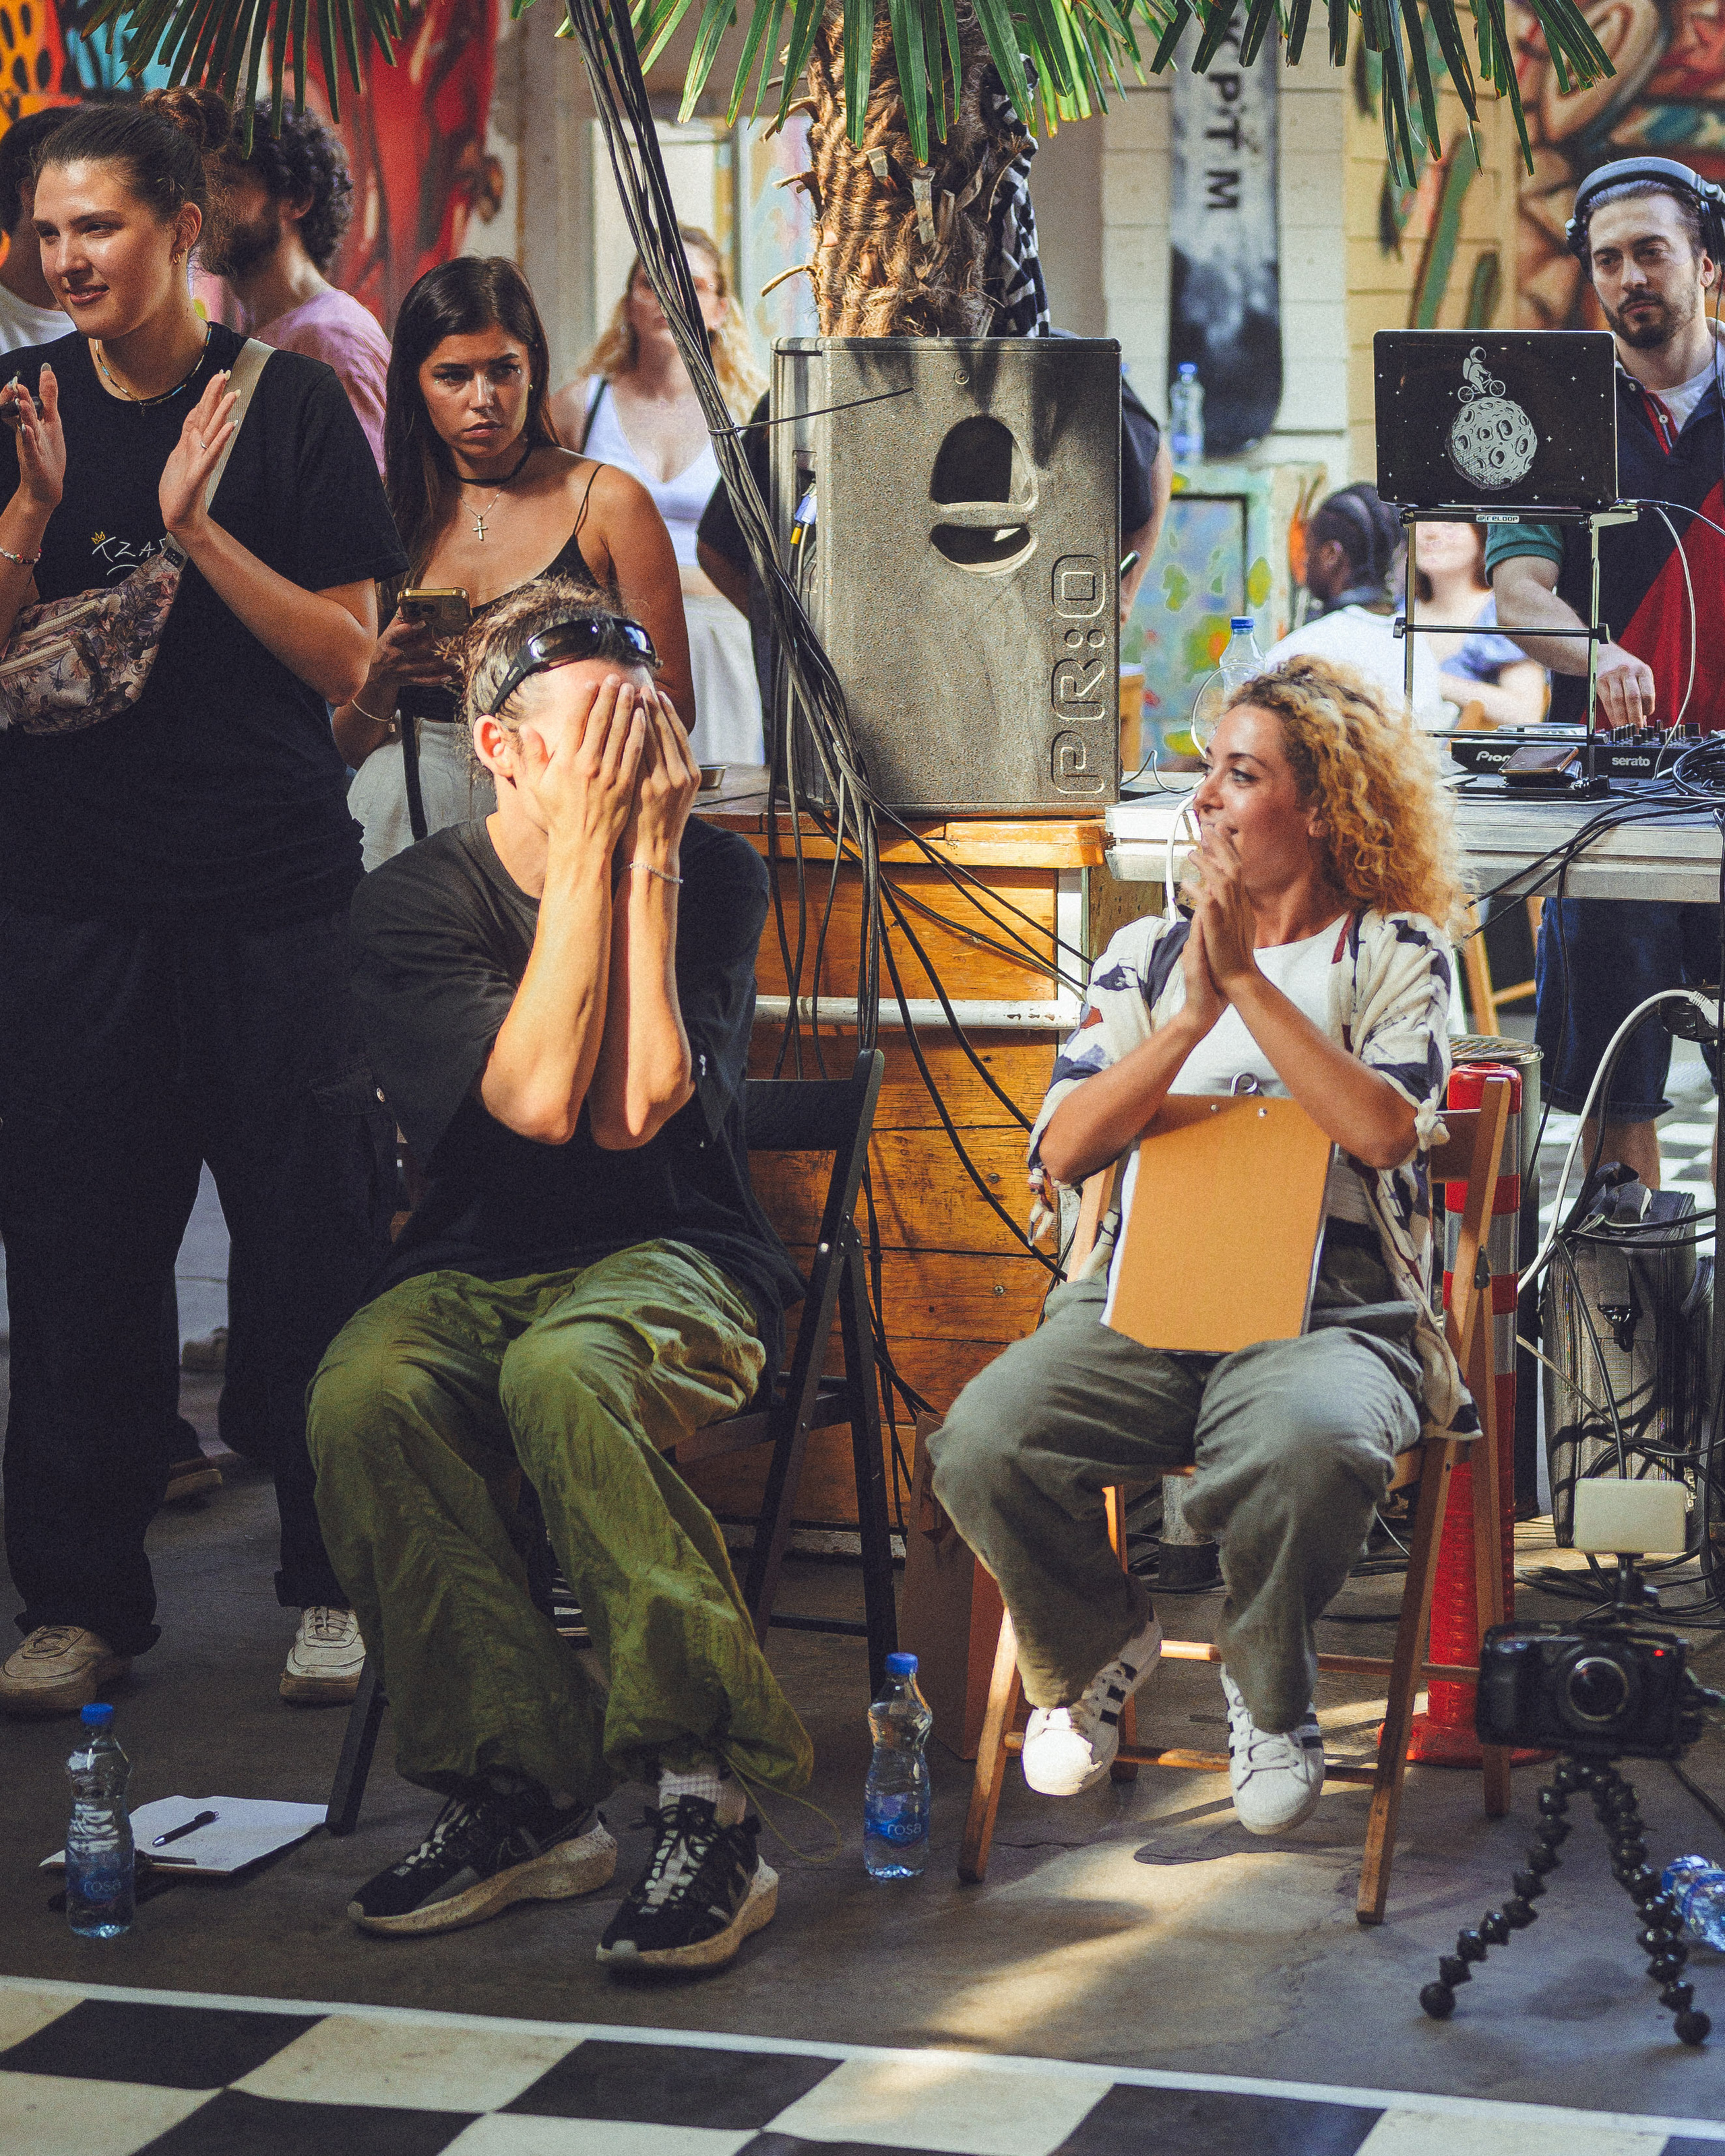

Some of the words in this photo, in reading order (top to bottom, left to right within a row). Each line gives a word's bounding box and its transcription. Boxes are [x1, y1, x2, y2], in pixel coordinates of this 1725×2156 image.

[92, 536, 166, 563] TZA
[1476, 751, 1511, 762] Pion
[1611, 756, 1650, 767] serato
[887, 1823, 922, 1835] rosa
